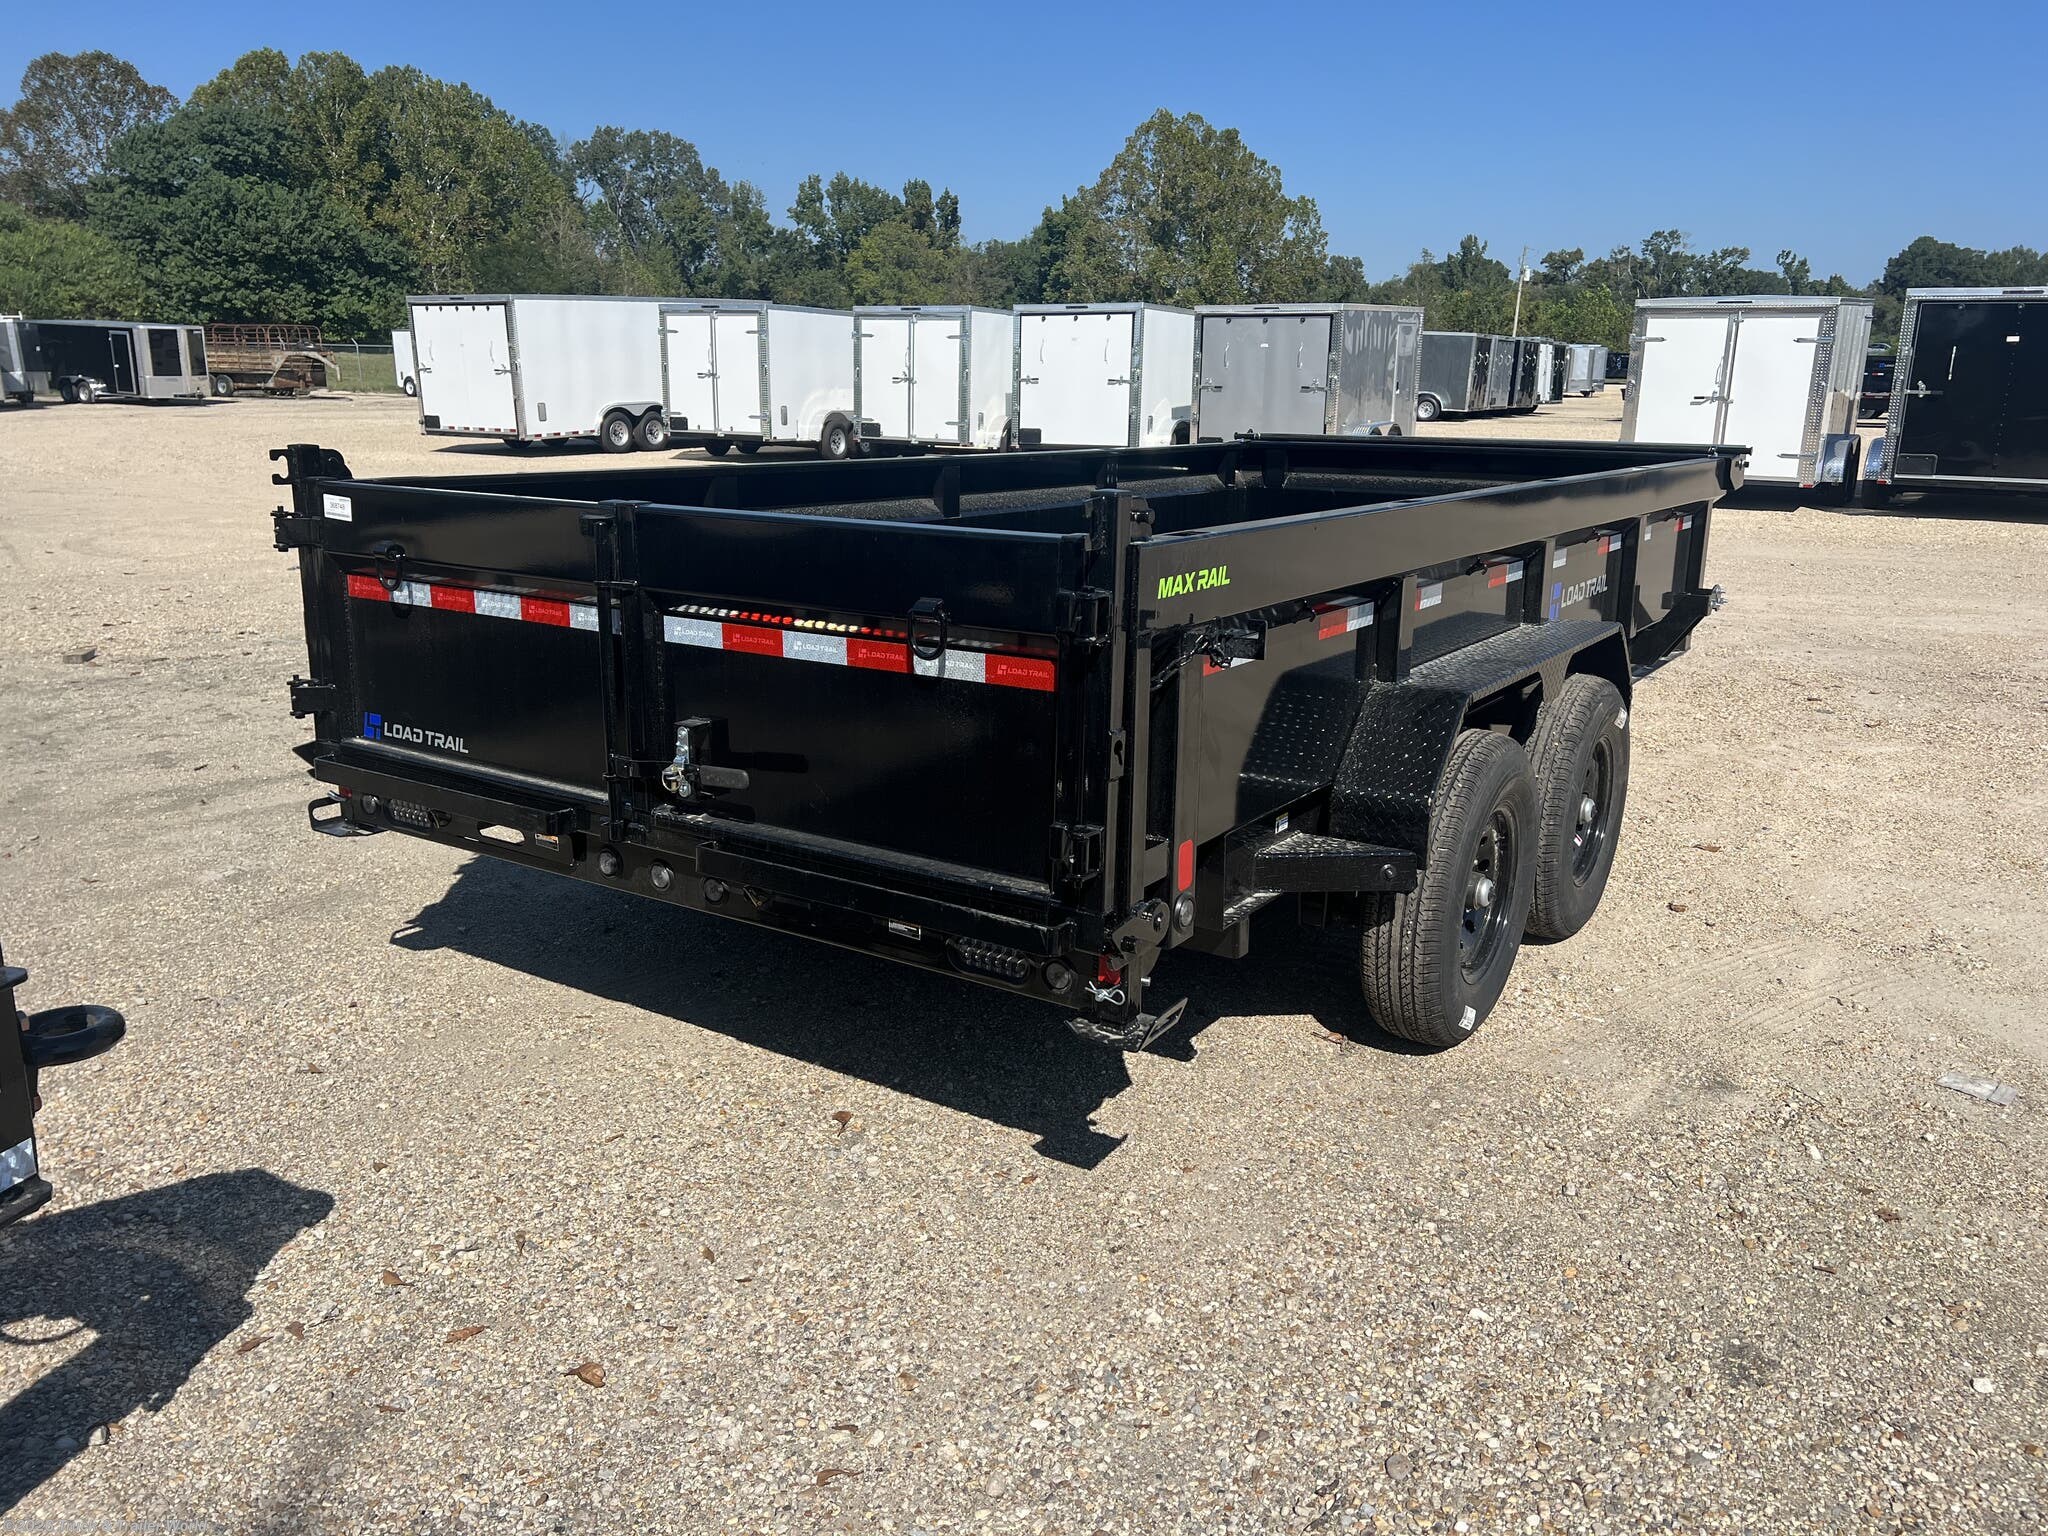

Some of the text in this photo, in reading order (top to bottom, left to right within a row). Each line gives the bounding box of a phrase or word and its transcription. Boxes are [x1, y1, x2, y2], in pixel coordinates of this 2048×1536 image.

[1157, 565, 1231, 600] MAX RAIL
[1560, 573, 1608, 609] LOAD TRAIL
[740, 636, 758, 644] LOAD
[757, 637, 776, 646] TRAIL
[802, 643, 838, 653] LOAD TRAIL
[867, 651, 905, 661] LOAD TRAIL
[955, 661, 977, 670] TRAIL
[1007, 668, 1050, 679] LOAD TRAIL
[383, 721, 469, 754] LOAD TRAIL
